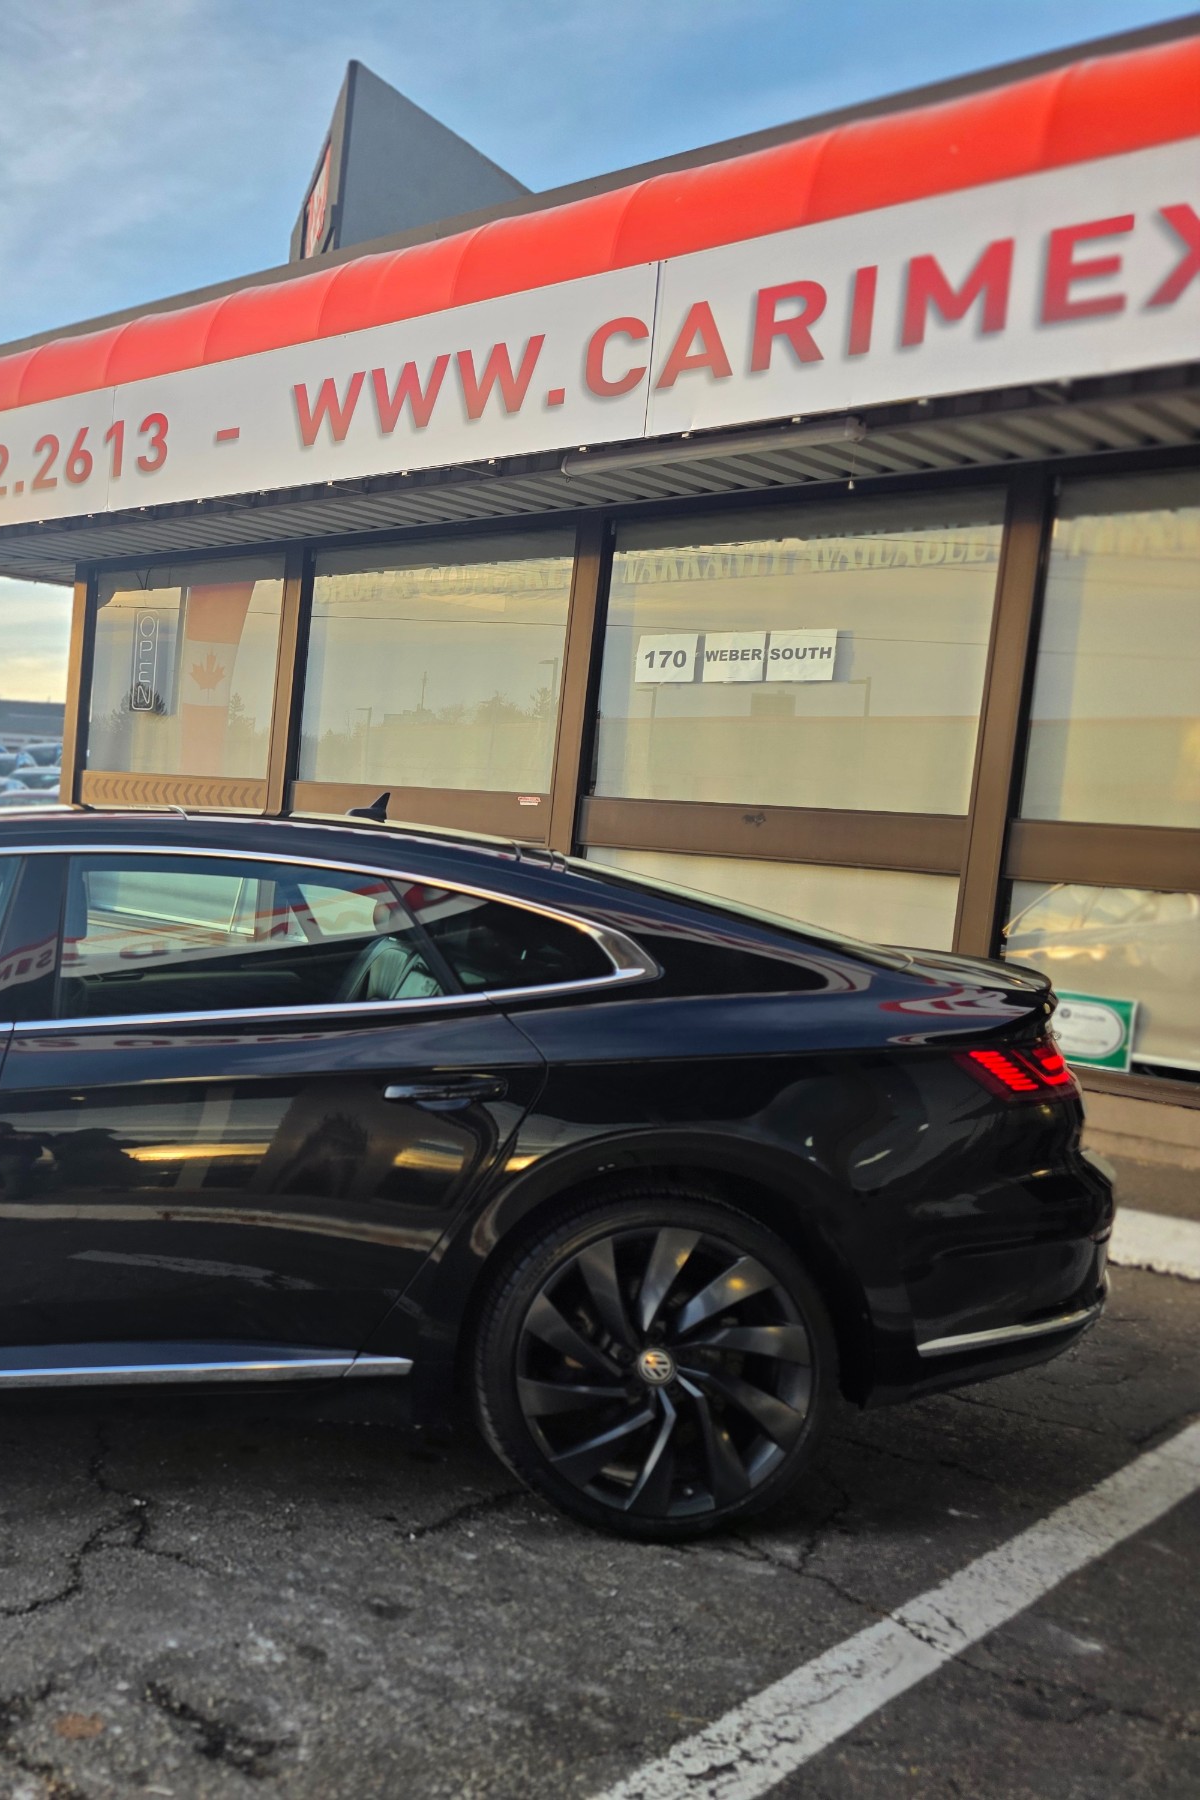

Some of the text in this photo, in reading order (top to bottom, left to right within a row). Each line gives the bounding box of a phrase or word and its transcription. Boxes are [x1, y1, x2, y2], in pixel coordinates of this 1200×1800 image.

[138, 616, 156, 704] OPEN
[644, 647, 833, 669] 170 WEBER SOUTH
